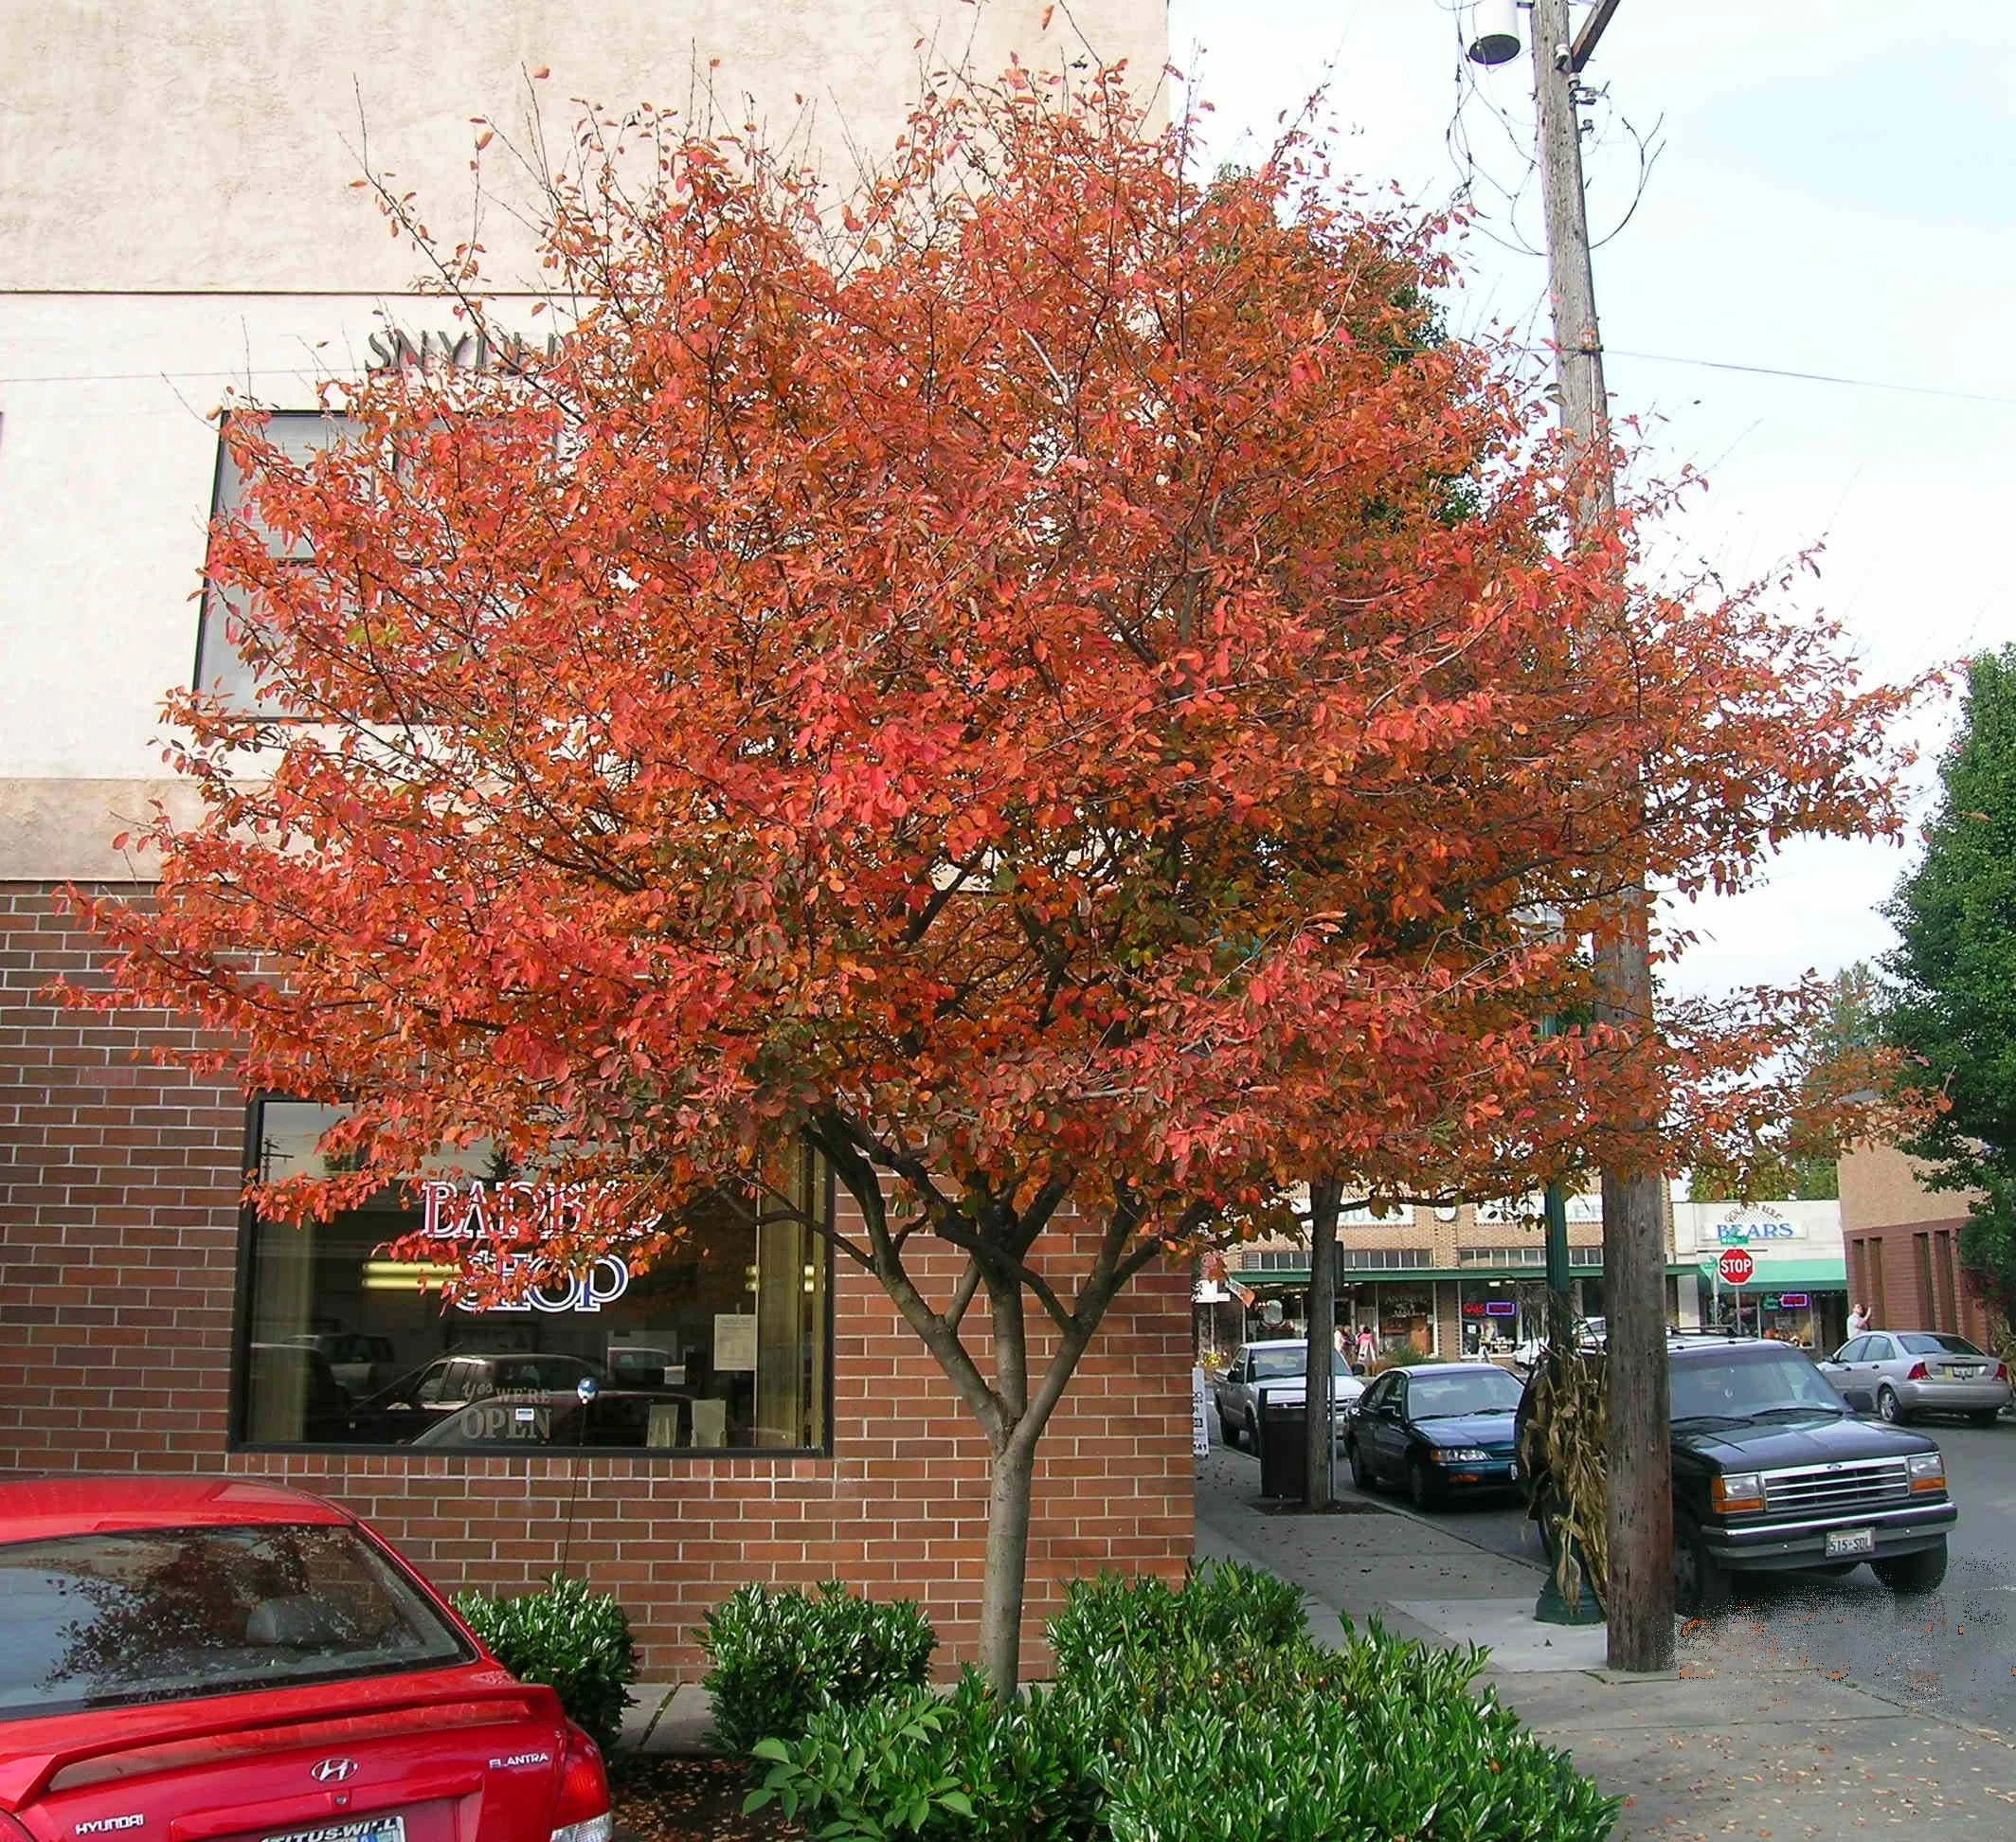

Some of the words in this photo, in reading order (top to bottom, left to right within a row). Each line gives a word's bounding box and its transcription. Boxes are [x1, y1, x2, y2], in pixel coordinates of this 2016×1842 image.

[1720, 1258, 1752, 1273] STOP
[461, 1407, 552, 1439] OPEN
[489, 1752, 549, 1769] ELANTRA
[75, 1814, 144, 1835] HYUNDAI
